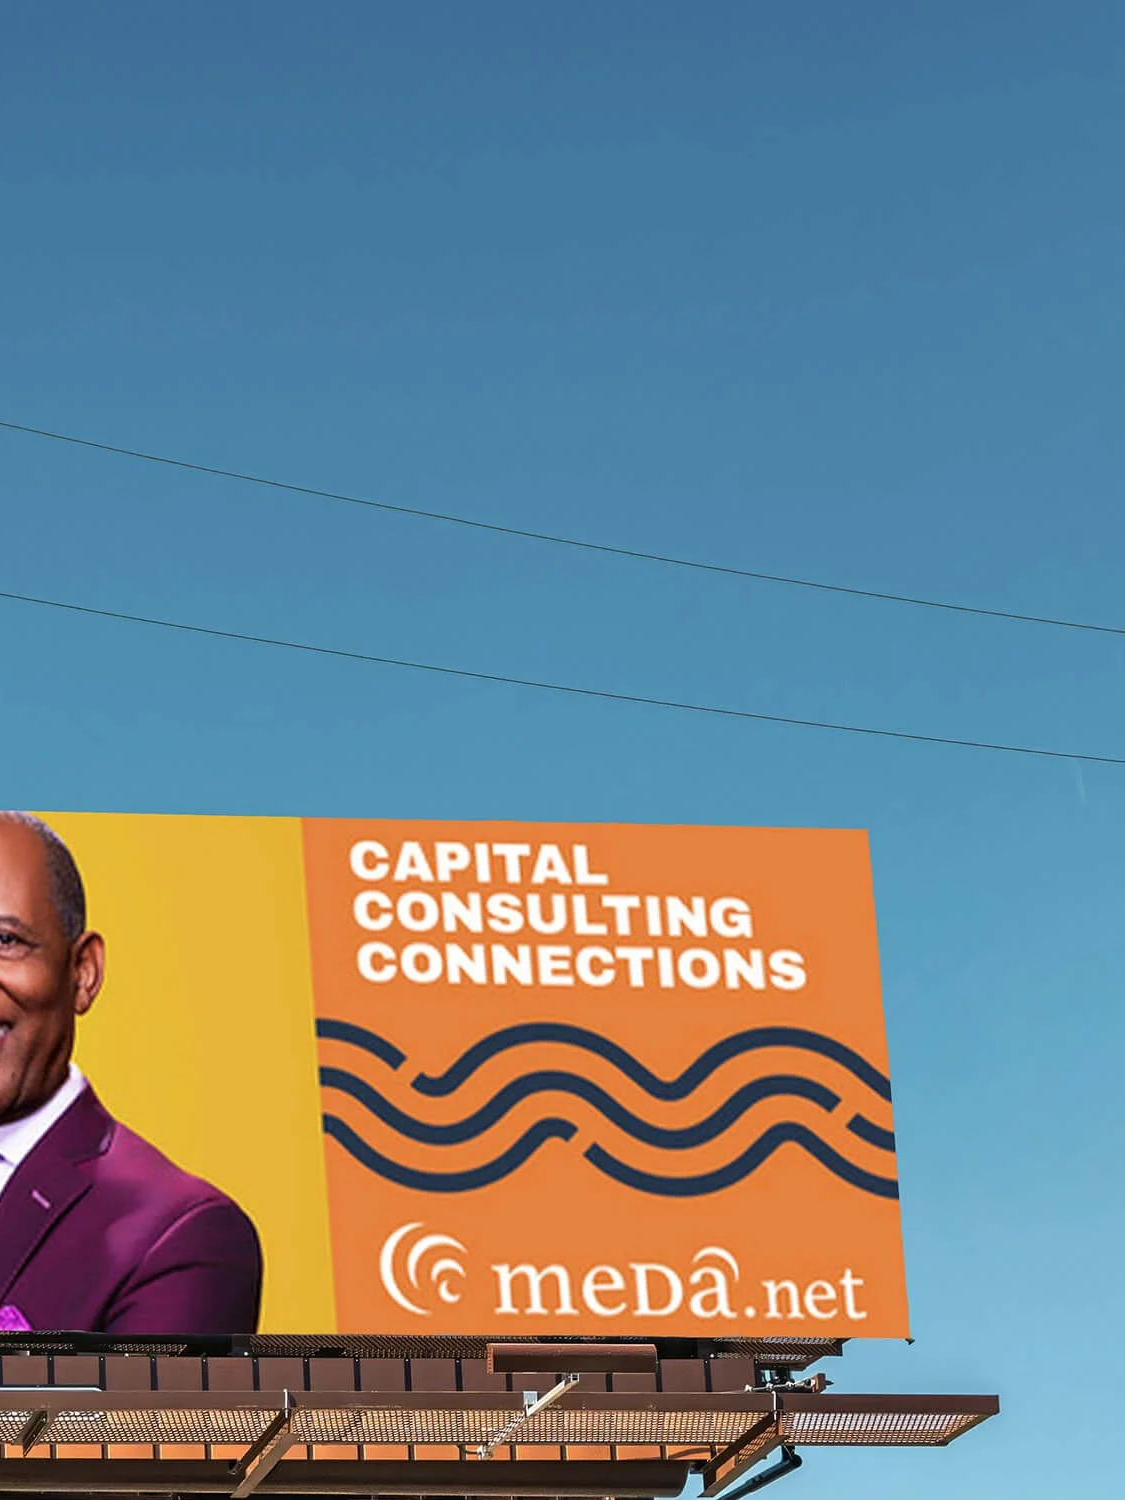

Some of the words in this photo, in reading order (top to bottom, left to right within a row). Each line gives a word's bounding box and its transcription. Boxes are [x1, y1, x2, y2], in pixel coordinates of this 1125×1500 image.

[349, 839, 610, 886] CAPITAL
[352, 890, 754, 939] CONSULTING
[356, 941, 808, 991] CONNECTIONS
